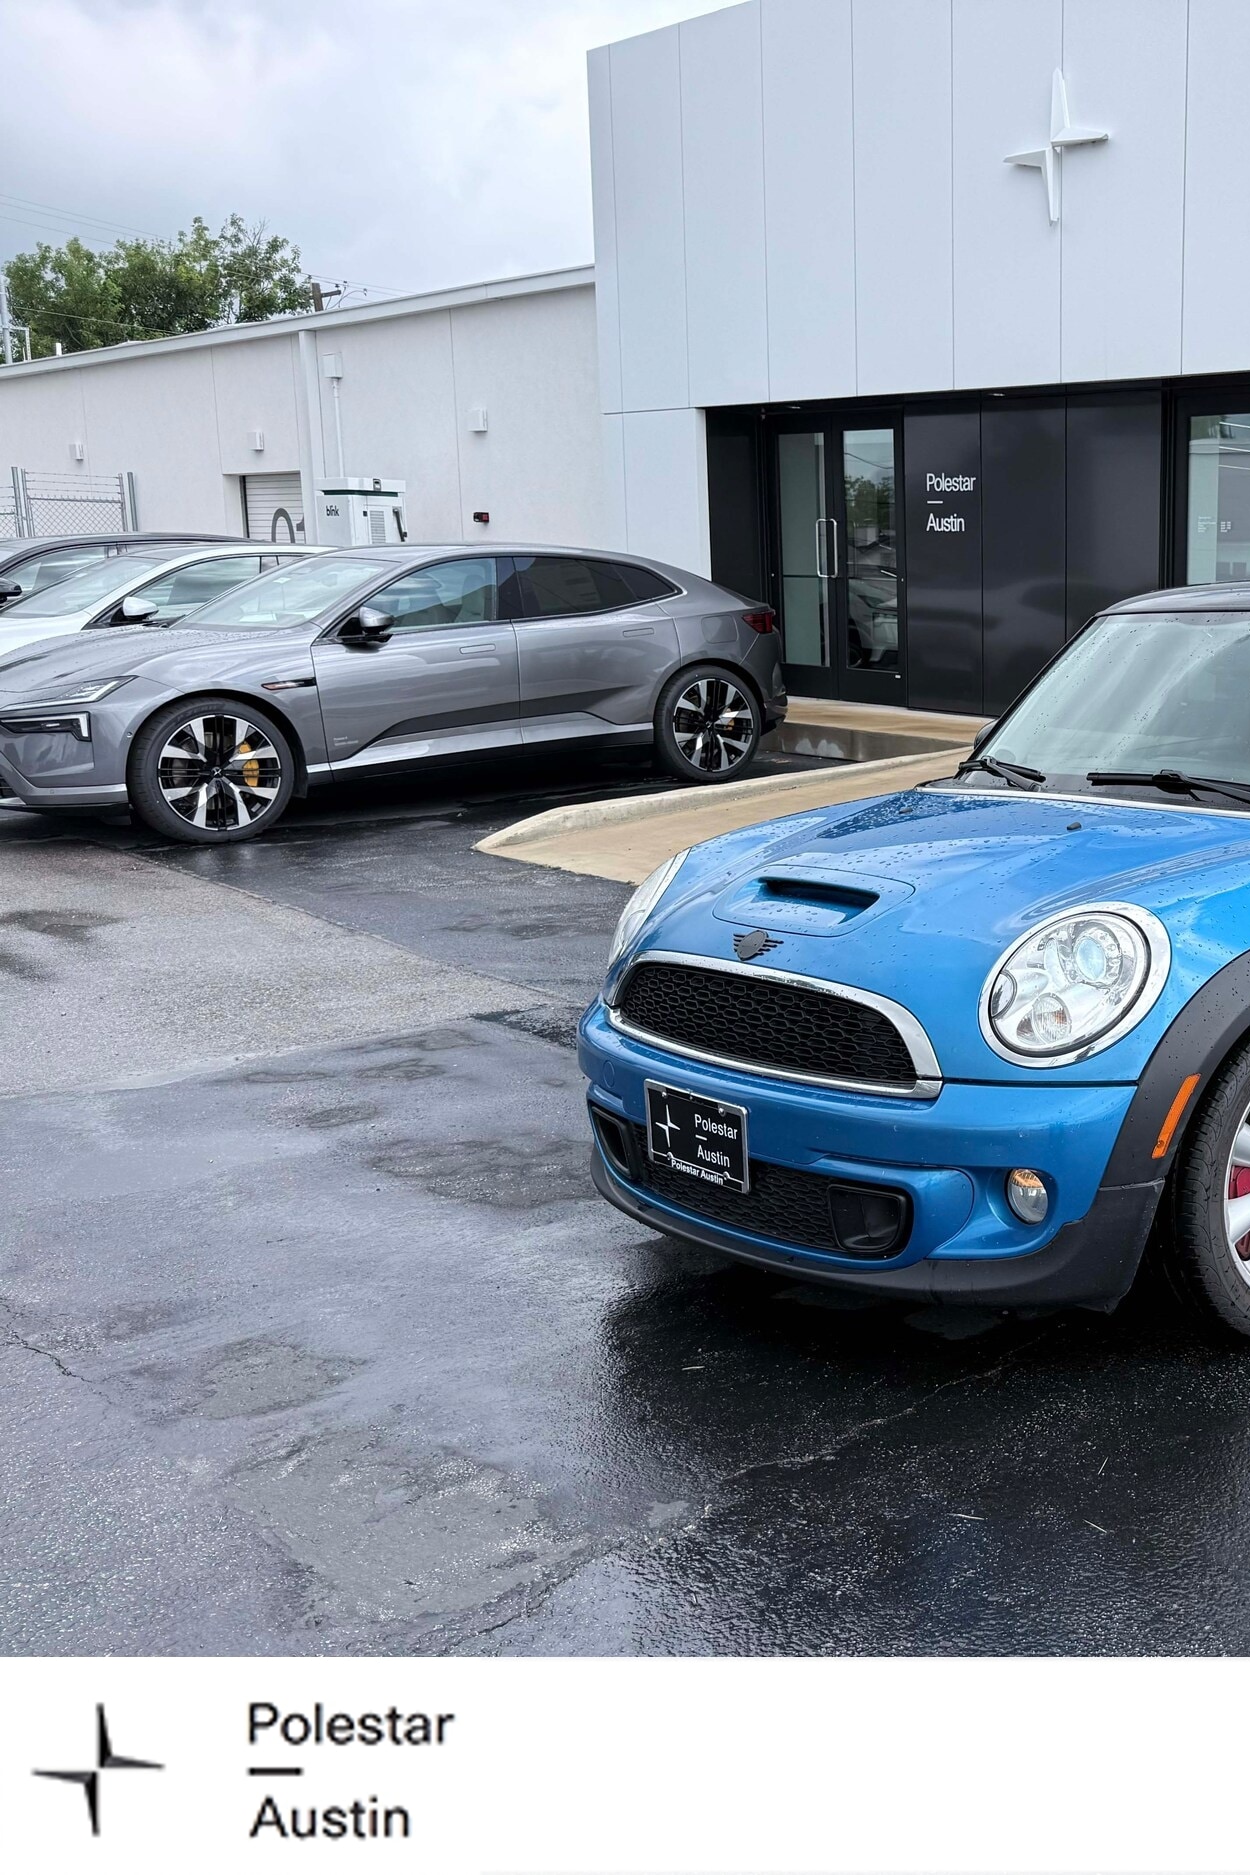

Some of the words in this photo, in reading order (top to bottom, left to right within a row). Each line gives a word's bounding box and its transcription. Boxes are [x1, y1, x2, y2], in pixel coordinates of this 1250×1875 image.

[926, 472, 977, 491] Polestar
[926, 512, 965, 532] Austin
[694, 1113, 738, 1140] Polestar
[697, 1144, 731, 1168] Austin
[671, 1159, 700, 1177] Polestar
[701, 1169, 725, 1186] Austin
